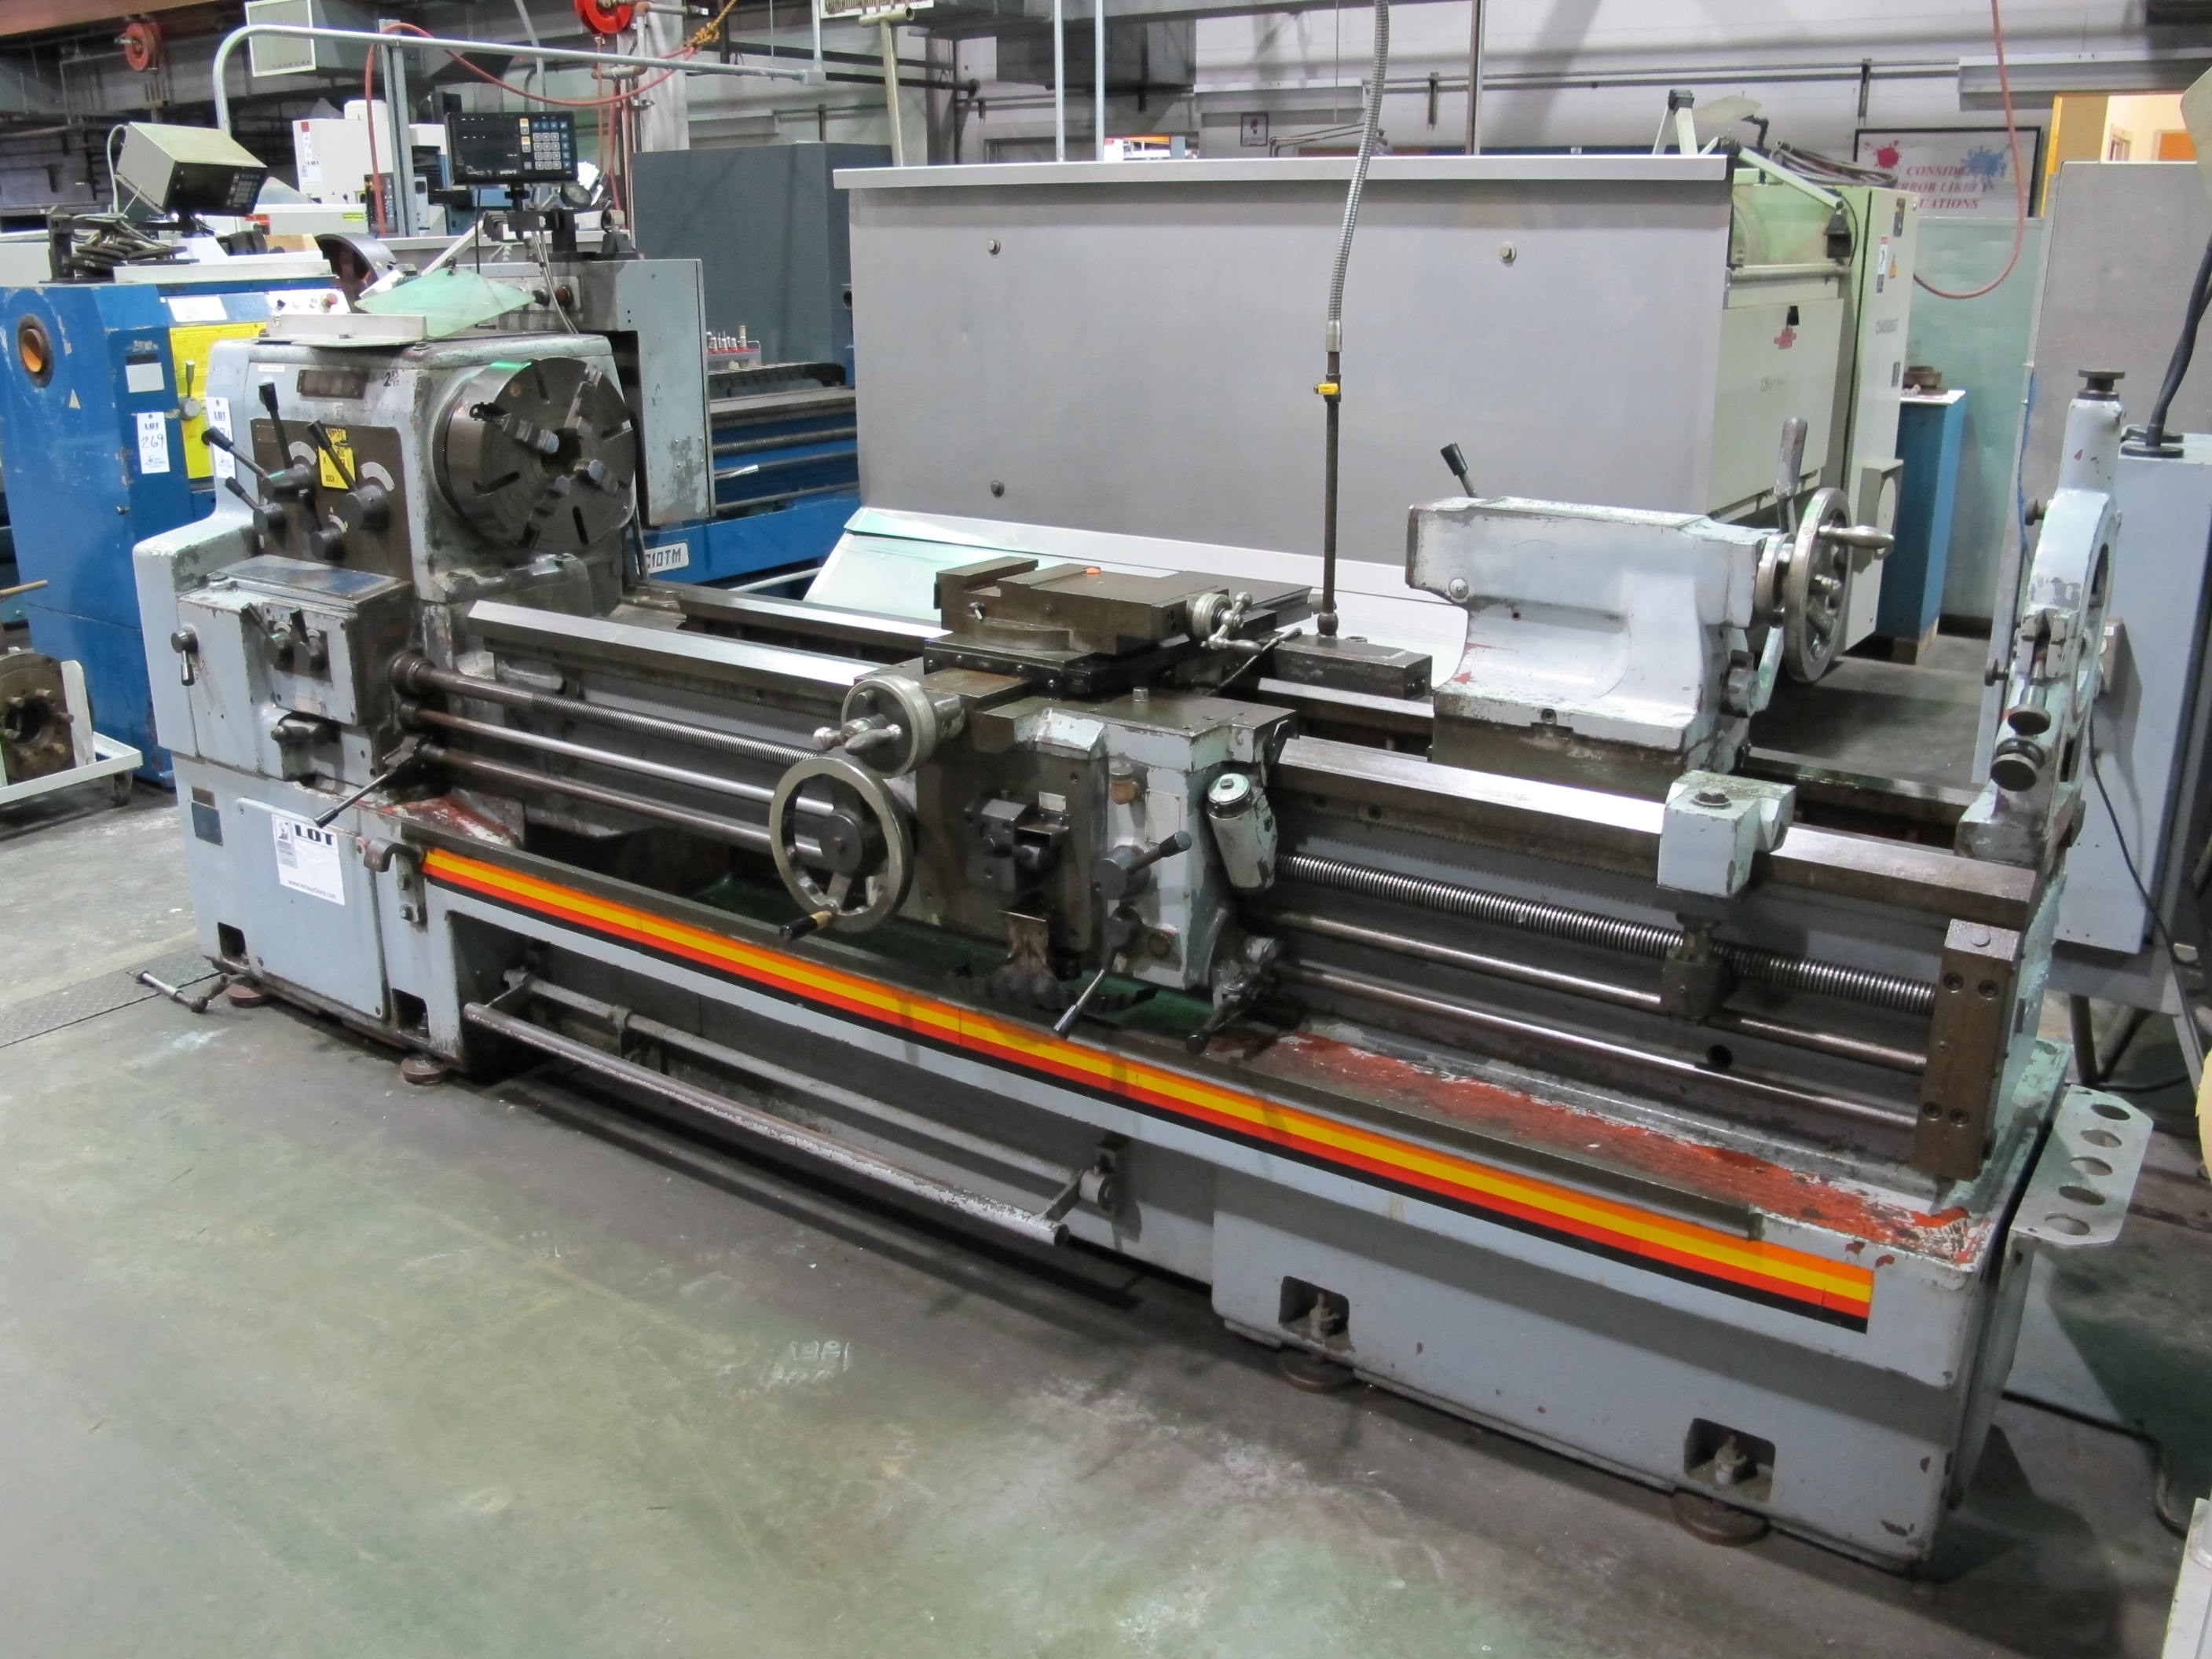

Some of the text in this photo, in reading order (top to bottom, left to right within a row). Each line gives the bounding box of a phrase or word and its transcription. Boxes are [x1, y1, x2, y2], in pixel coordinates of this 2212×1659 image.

[1897, 181, 1937, 192] RROR
[1918, 198, 1979, 209] UATIONS
[214, 412, 226, 420] LOT
[141, 434, 164, 450] 269
[295, 824, 335, 846] LOT
